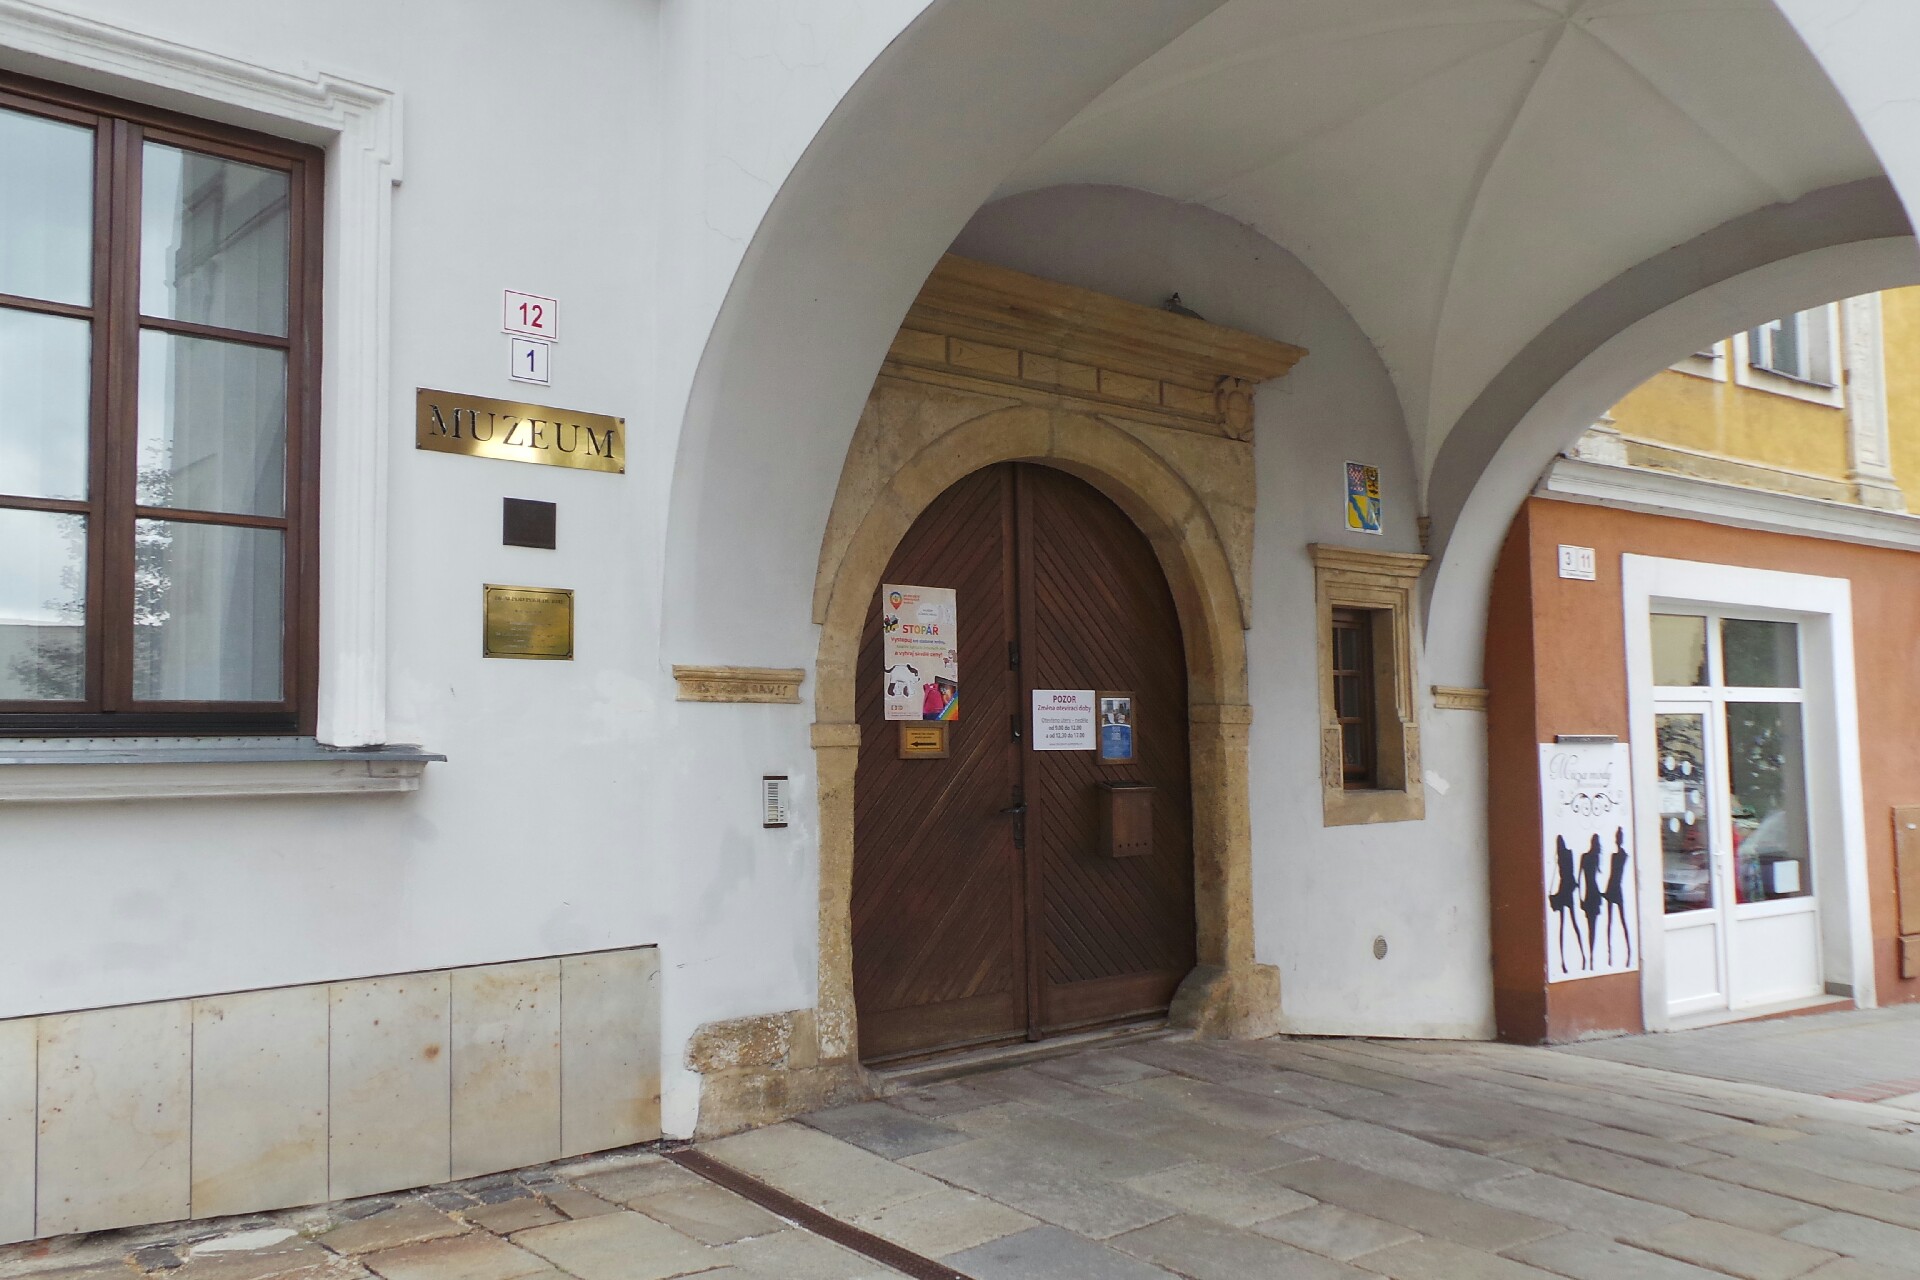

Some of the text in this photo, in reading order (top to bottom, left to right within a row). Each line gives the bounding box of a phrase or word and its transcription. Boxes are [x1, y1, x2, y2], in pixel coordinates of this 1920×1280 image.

[519, 302, 543, 328] 12
[526, 349, 535, 373] 1
[428, 403, 616, 460] MUZEUM
[1580, 553, 1591, 569] 11
[902, 623, 939, 636] STOPÁŘ
[1053, 695, 1077, 704] POZOR
